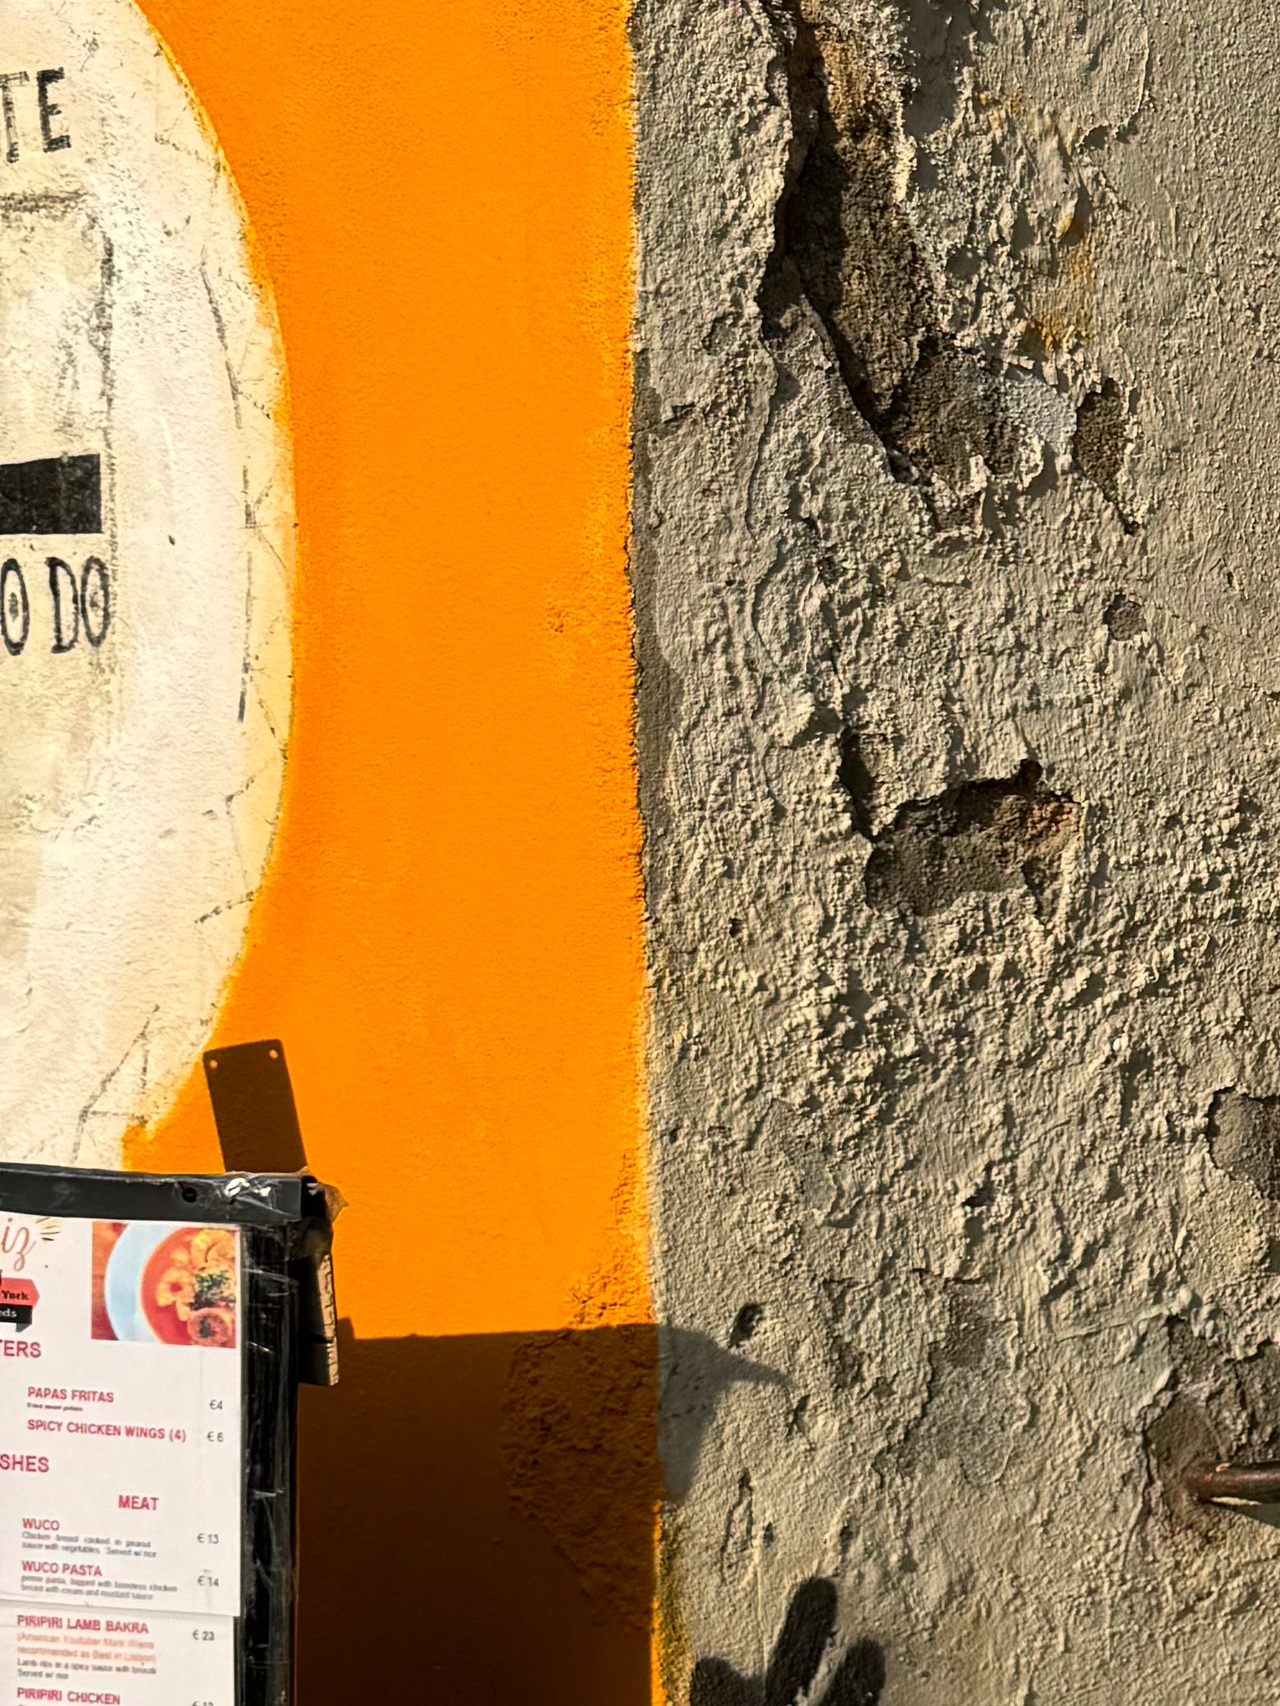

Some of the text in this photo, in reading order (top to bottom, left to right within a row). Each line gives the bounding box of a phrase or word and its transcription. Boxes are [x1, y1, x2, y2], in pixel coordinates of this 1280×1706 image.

[44, 555, 110, 654] DO
[0, 1339, 42, 1359] ERS
[27, 1386, 115, 1403] PAPAS FRITAS
[27, 1419, 187, 1444] SPICY CHICKEN WINGS (4)
[0, 1453, 50, 1474] SHES
[118, 1494, 160, 1511] MEAT
[22, 1518, 60, 1531] WUCO
[21, 1560, 103, 1577] WUCO PASTA
[17, 1615, 149, 1634] PIRIPIRI LAMB BAKRA
[17, 1687, 121, 1705] PIRIPIRI CHICKEN
